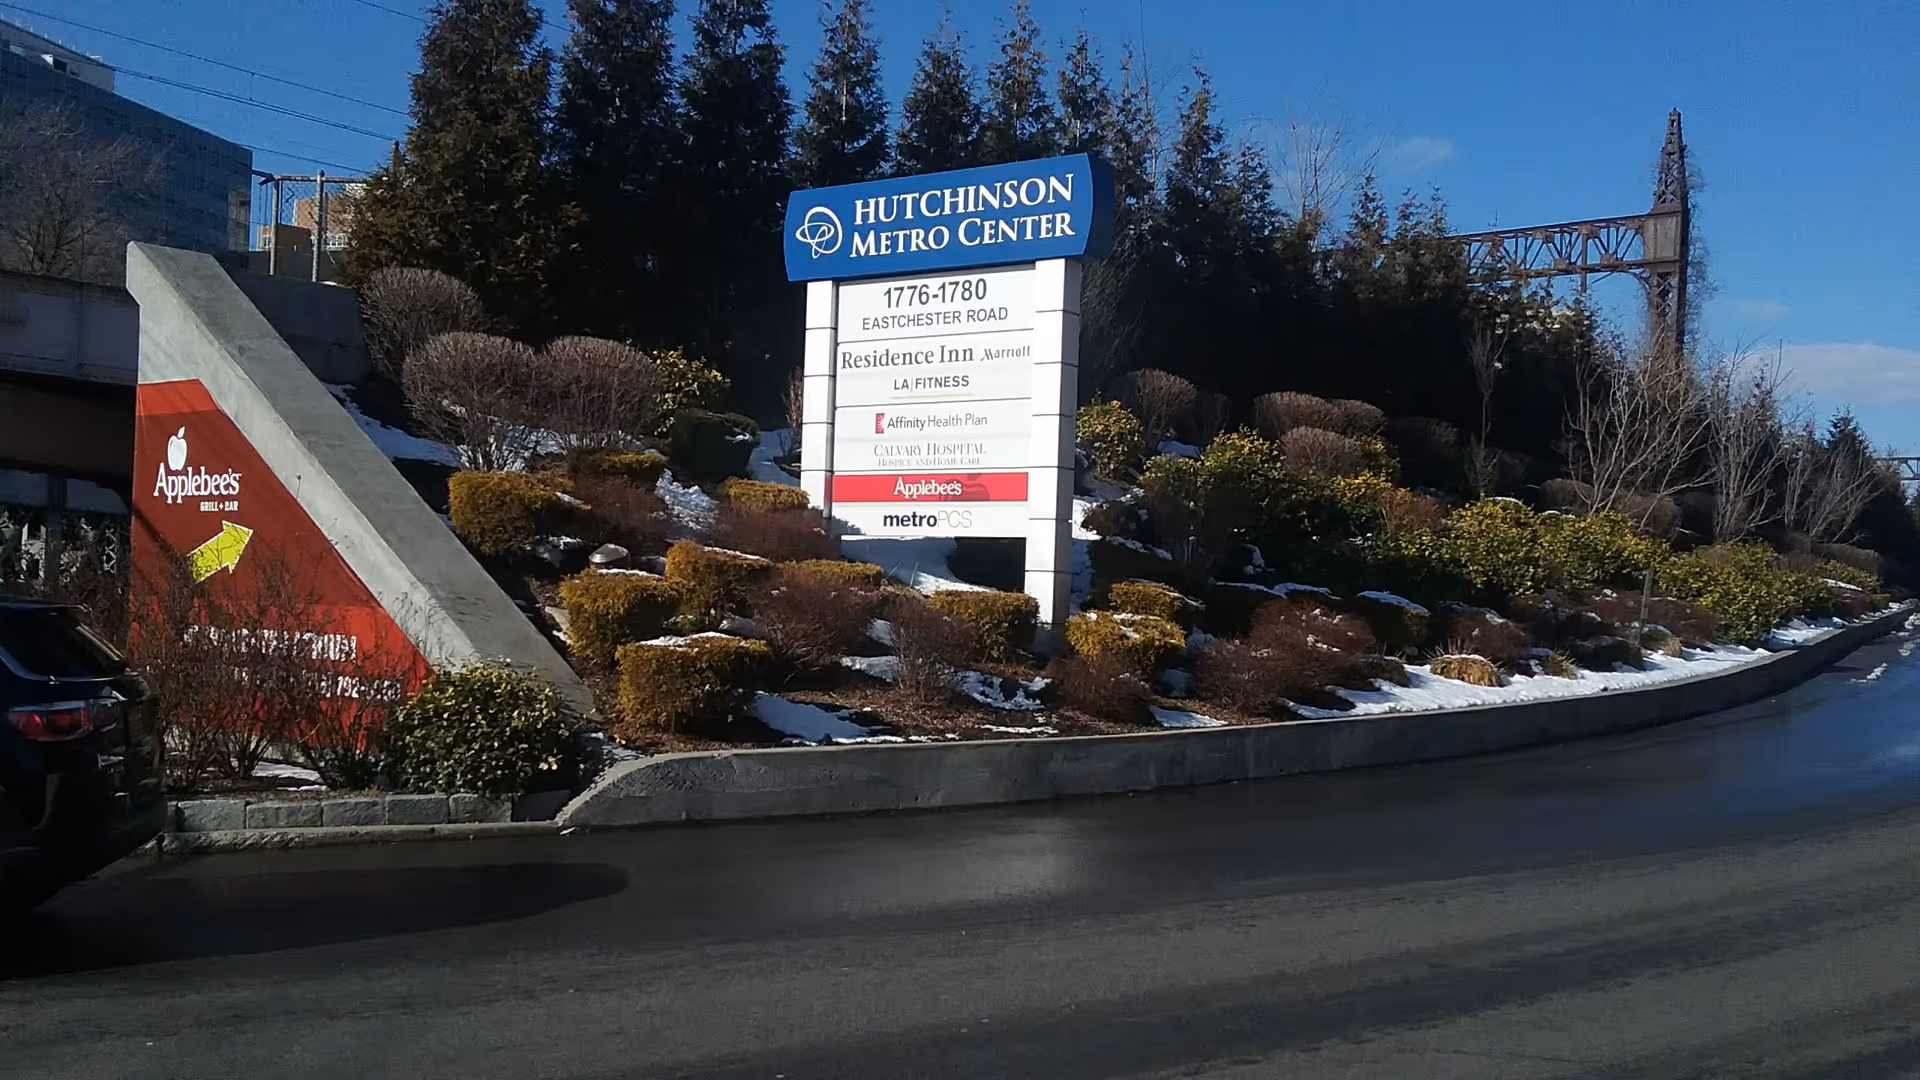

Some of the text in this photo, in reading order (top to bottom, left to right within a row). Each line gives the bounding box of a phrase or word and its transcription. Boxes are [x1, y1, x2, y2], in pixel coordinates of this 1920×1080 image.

[854, 174, 1074, 225] HUTCHINSON
[850, 212, 1076, 258] METRO CENTER
[883, 278, 988, 309] 1776-1780
[862, 307, 1008, 331] EASTCHESTER ROAD
[841, 345, 1031, 370] Residence Inn Marriott
[886, 412, 988, 432] Affinity Health Plan
[873, 442, 987, 457] CALVARY HOSPITAL
[153, 462, 241, 504] Applebee's
[893, 476, 962, 499] Applebee's
[199, 501, 219, 512] GRILL
[224, 501, 239, 512] BAR
[883, 510, 972, 529] metroPCS
